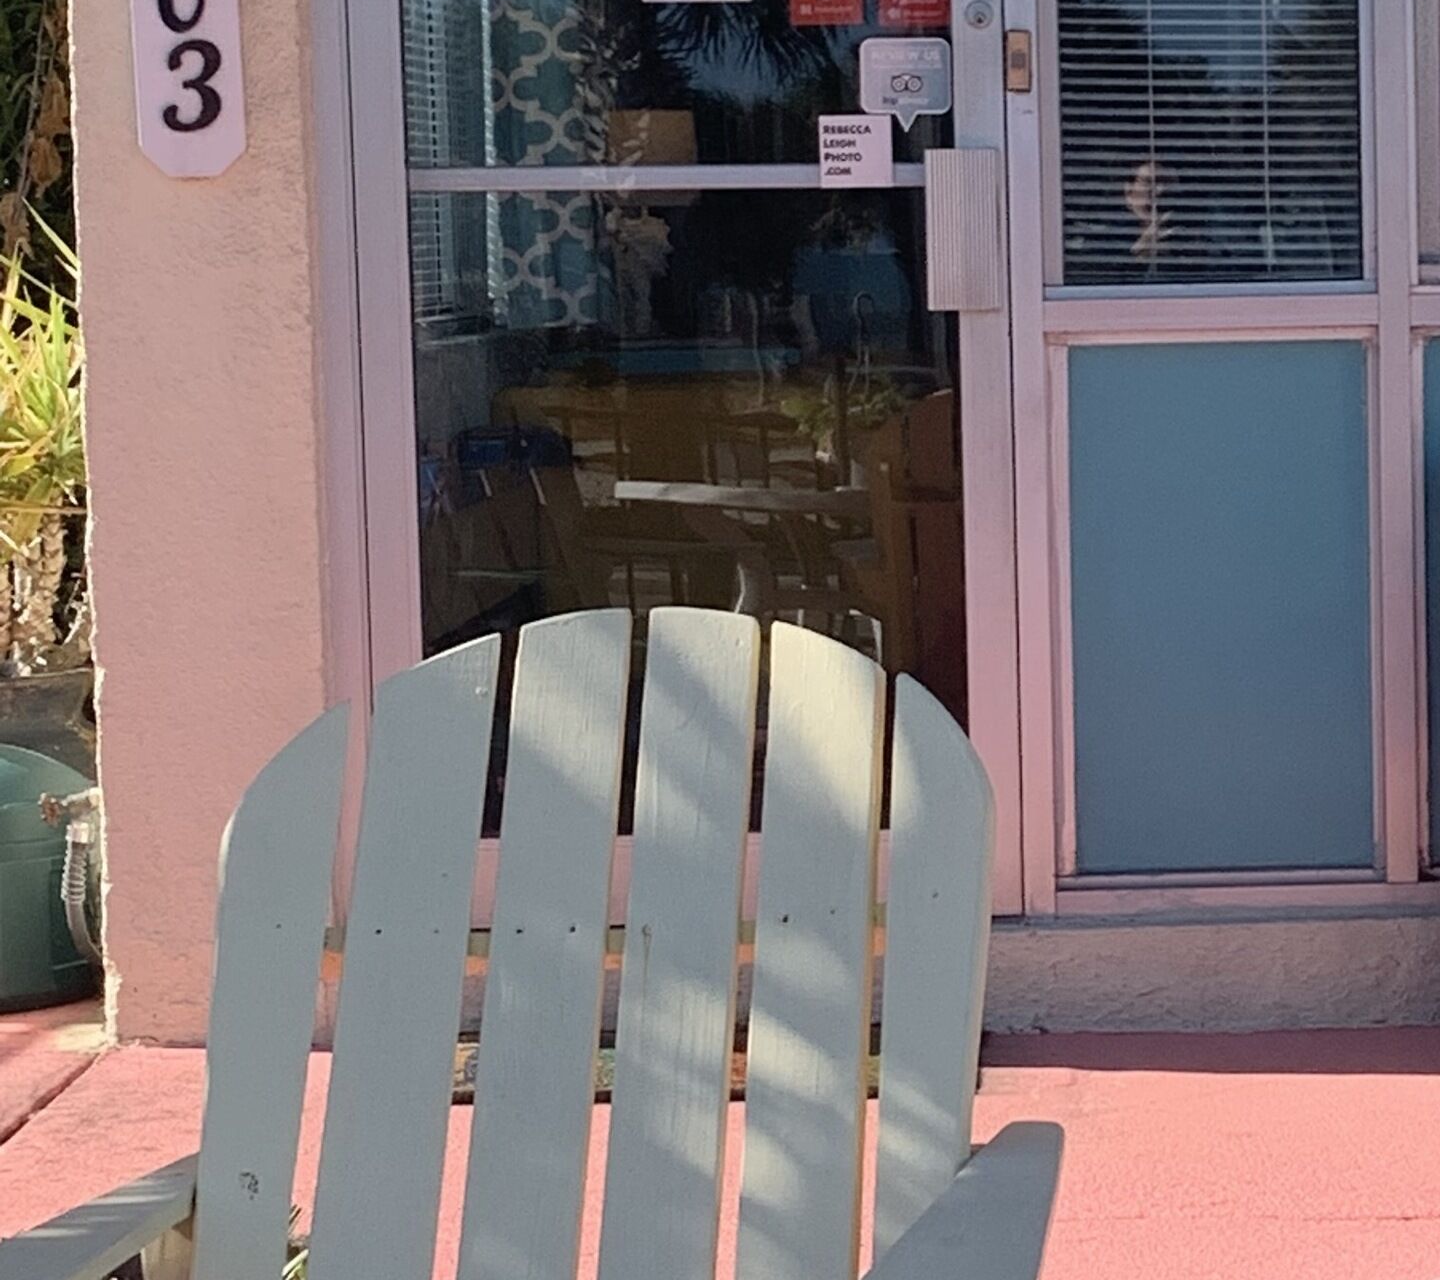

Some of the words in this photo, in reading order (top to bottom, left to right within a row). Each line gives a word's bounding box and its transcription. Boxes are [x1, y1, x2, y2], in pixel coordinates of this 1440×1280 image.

[822, 124, 872, 135] REBECCA
[823, 138, 857, 149] LEIGH
[823, 152, 863, 162] PHOTO
